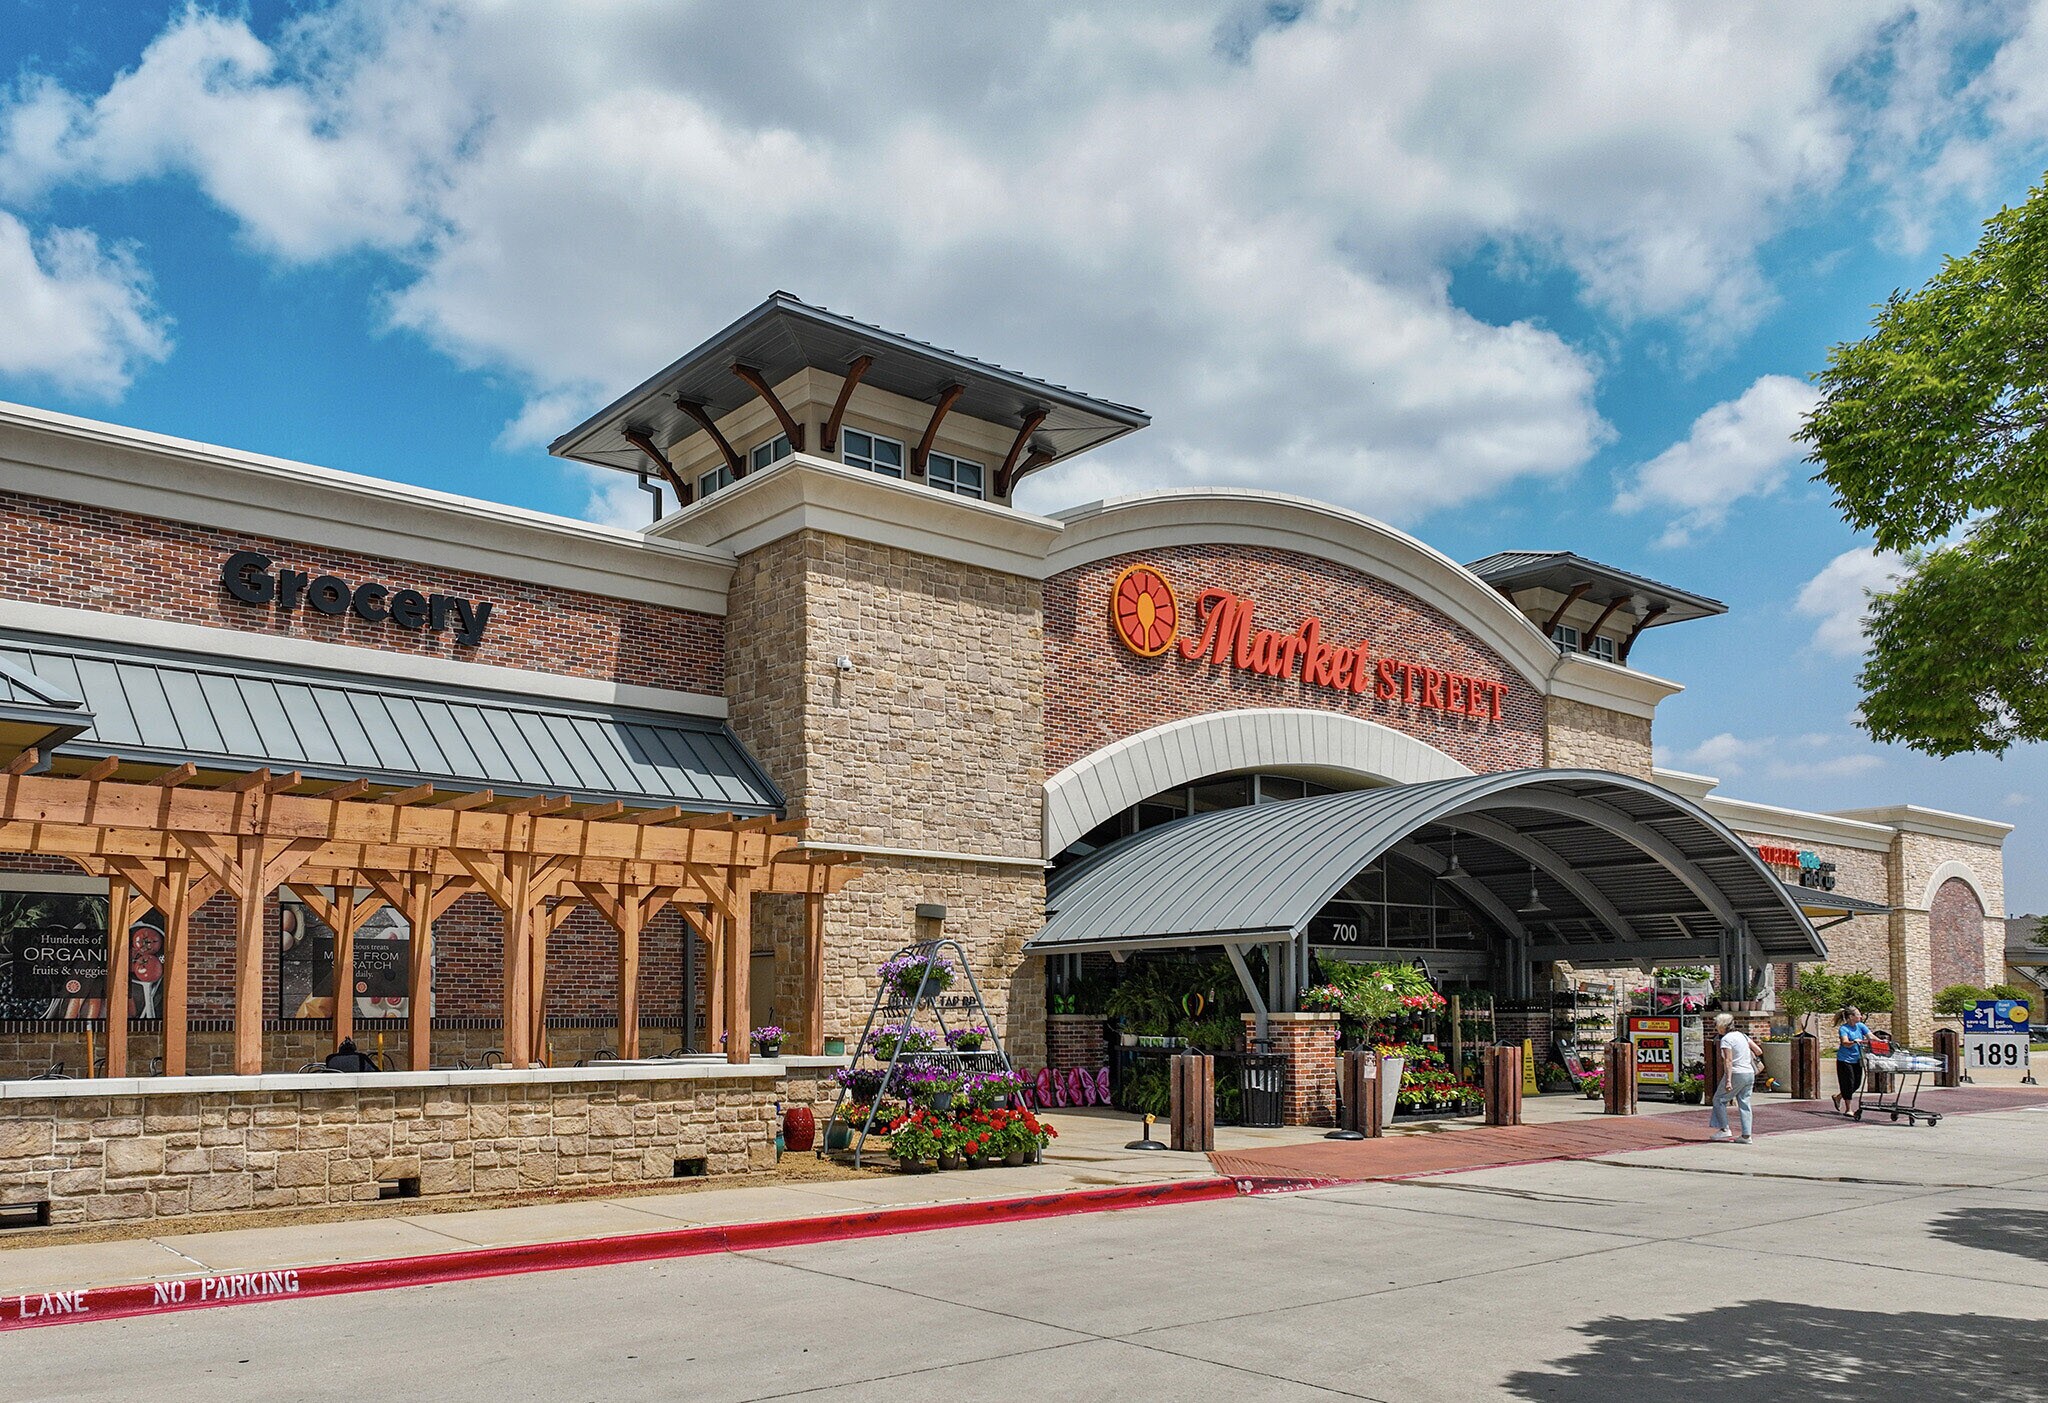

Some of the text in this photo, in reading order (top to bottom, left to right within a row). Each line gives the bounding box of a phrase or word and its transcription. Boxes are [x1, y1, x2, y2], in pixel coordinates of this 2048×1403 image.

[222, 551, 493, 646] Grocery
[1179, 587, 1508, 720] Market STREET
[40, 934, 103, 945] Hundreds of
[1333, 923, 1357, 941] 700
[24, 947, 107, 962] ORGANI
[323, 951, 399, 961] ME FROM
[32, 965, 59, 976] fruits
[61, 966, 71, 976] &
[1641, 1039, 1664, 1047] CYBER
[1637, 1049, 1670, 1063] SALE
[1973, 1043, 2018, 1066] 189
[19, 1269, 300, 1318] LANE NO PARKING
